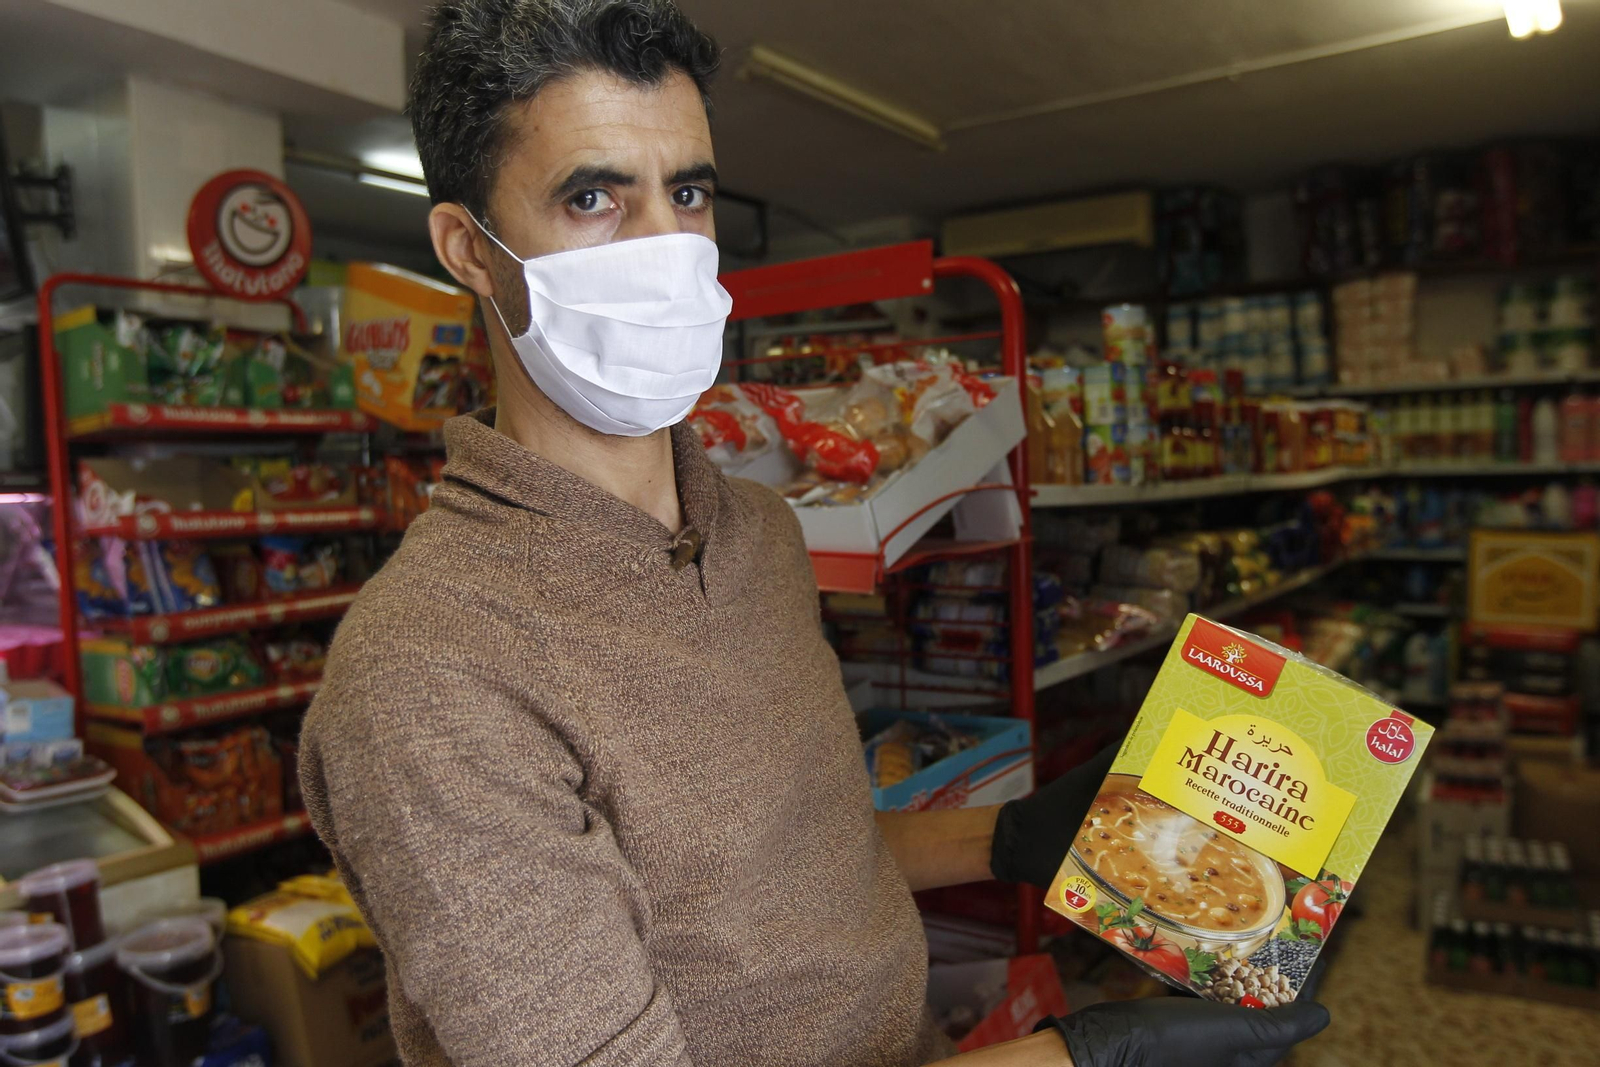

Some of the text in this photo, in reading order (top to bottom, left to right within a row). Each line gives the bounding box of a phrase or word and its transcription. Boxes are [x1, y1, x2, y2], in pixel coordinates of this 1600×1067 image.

[1188, 648, 1263, 691] LAAROUSSA
[1247, 724, 1293, 756] حريرة
[1378, 722, 1408, 742] حلال
[1370, 736, 1404, 758] halal
[1202, 729, 1308, 803] Harira
[1176, 746, 1315, 831] Marocaine
[1185, 778, 1290, 838] Recette traditionnelle
[1220, 815, 1239, 829] 555
[1071, 896, 1079, 905] 4
[1075, 883, 1086, 895] 10
